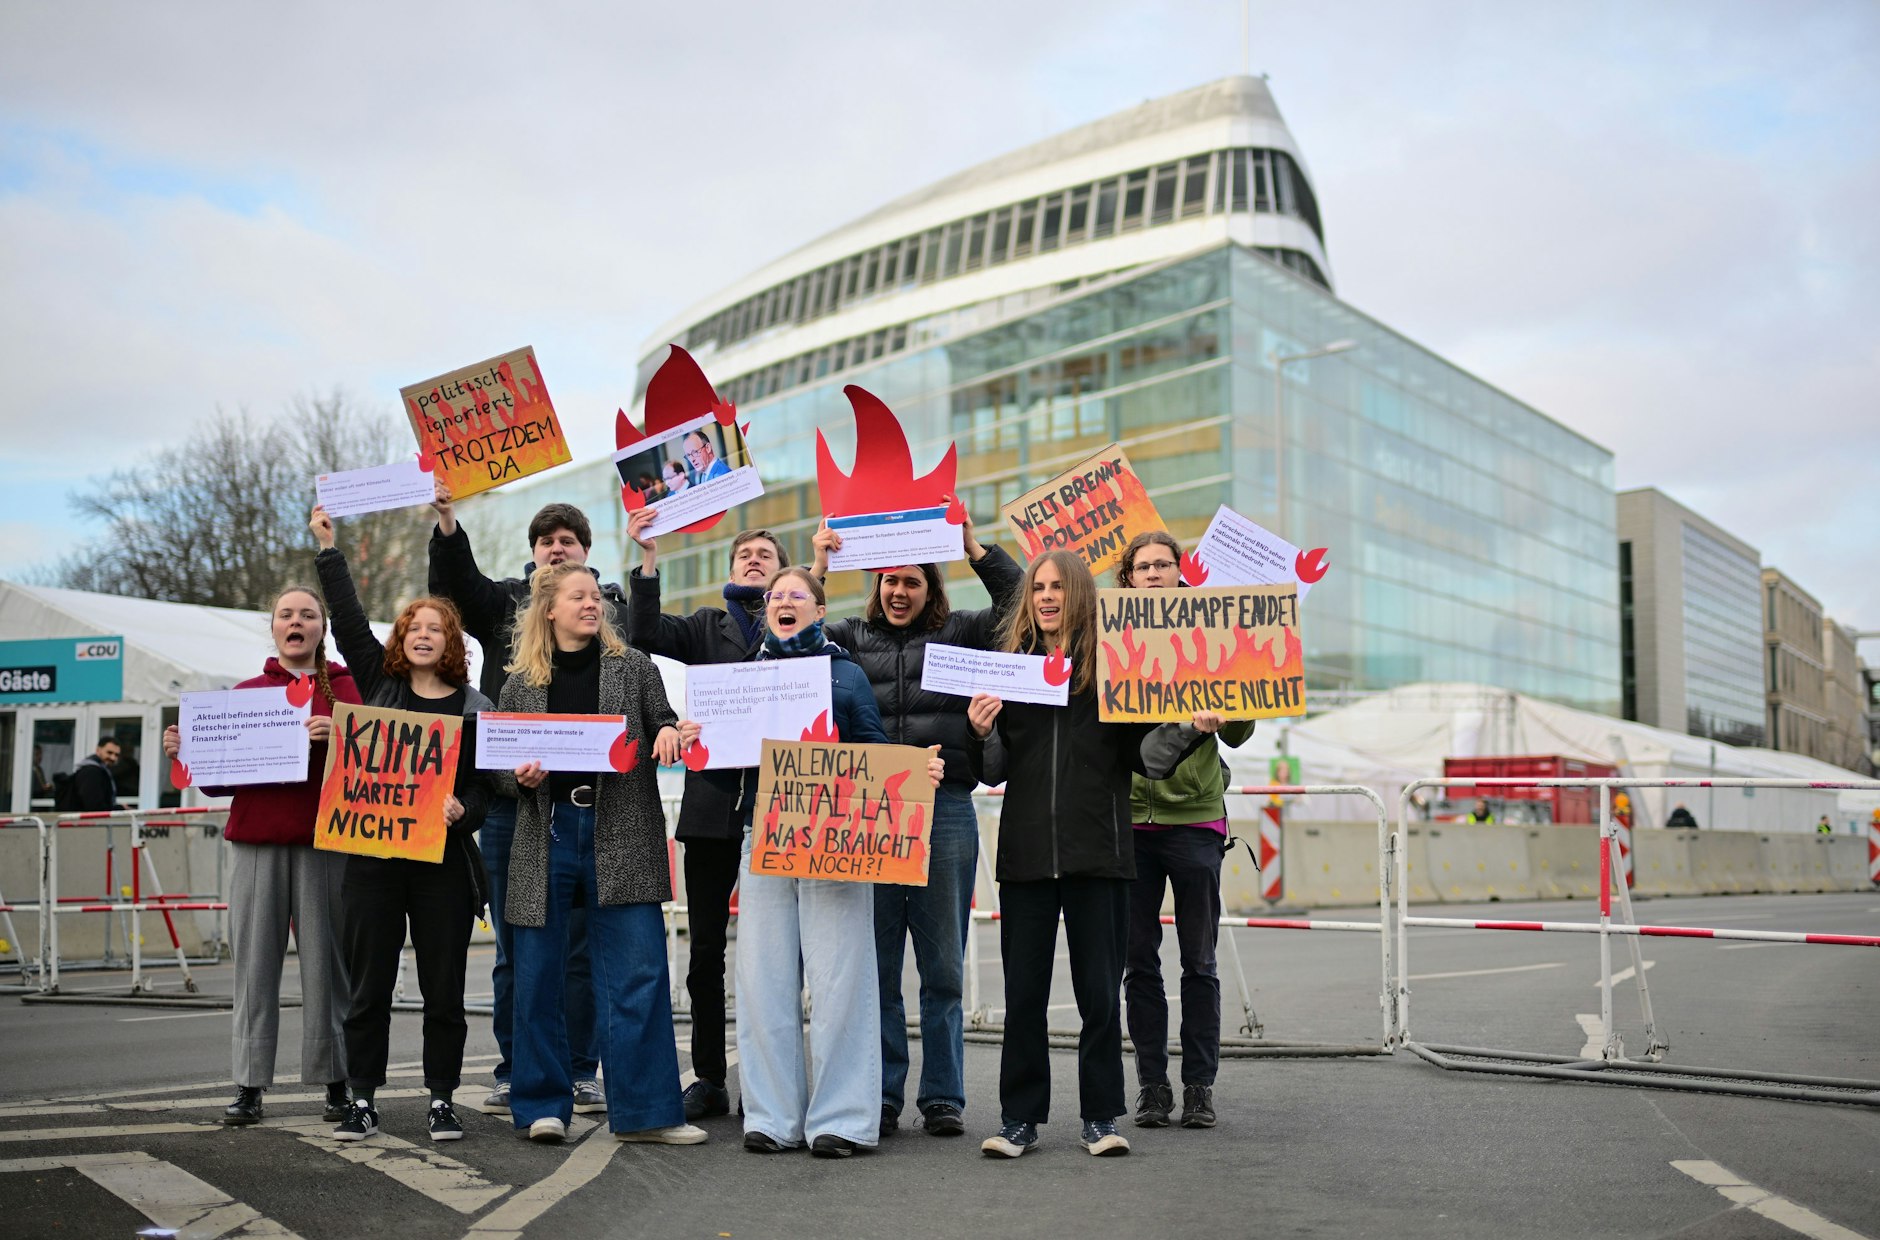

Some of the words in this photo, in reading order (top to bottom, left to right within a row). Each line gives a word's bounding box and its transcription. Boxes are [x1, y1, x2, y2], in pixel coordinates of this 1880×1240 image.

[418, 368, 506, 419] politisch
[425, 392, 513, 443] ignoriert
[434, 416, 556, 470] TROTZDEM
[488, 455, 520, 481] DA
[1011, 492, 1060, 533] WELT
[1059, 458, 1122, 506] BRENNT
[1043, 498, 1124, 550] POLITIK
[1219, 520, 1244, 538] Forscher
[1244, 534, 1257, 545] und
[1256, 540, 1269, 552] BND
[1268, 549, 1286, 562] sehen
[1075, 525, 1127, 567] ENNT
[1211, 534, 1241, 555] Klimakrise
[1241, 550, 1264, 568] bedroht
[1215, 527, 1241, 545] nationale
[1240, 541, 1270, 562] Sicherheit
[1270, 558, 1287, 572] durch
[1100, 595, 1235, 633] WAHLKAMPF
[1238, 593, 1297, 629] ENDET
[87, 644, 117, 657] CDU
[929, 653, 947, 661] Feuer
[994, 662, 1026, 671] teuersten
[0, 669, 51, 691] Gäste
[928, 661, 988, 675] Naturkatastrophen
[988, 668, 1000, 676] der
[693, 688, 724, 697] Umwelt
[725, 687, 740, 696] und
[742, 682, 793, 693] Klimawandel
[794, 681, 810, 689] laut
[694, 698, 728, 709] Umfrage
[729, 695, 765, 706] wichtiger
[767, 693, 779, 702] als
[780, 691, 818, 701] Migration
[1104, 678, 1237, 714] KLIMAKRISE
[1240, 676, 1303, 710] NICHT
[192, 712, 226, 722] „Aktuell
[227, 710, 263, 720] befinden
[264, 709, 280, 717] sich
[281, 708, 294, 716] die
[192, 723, 231, 732] Gletscher
[232, 722, 240, 730] in
[240, 721, 261, 730] einer
[262, 720, 301, 728] schweren
[694, 708, 710, 717] und
[710, 706, 752, 717] Wirtschaft
[344, 712, 443, 776] KLIMA
[578, 729, 584, 737] je
[772, 748, 874, 782] VALENCIA,
[344, 776, 420, 806] WARTET
[769, 780, 852, 822] AHRTAL,
[862, 788, 893, 824] LA
[328, 807, 417, 841] NICHT
[765, 822, 813, 848] WAS
[825, 827, 919, 859] BRAUCHT
[762, 851, 797, 871] ES
[809, 854, 883, 876] NOCH?!
